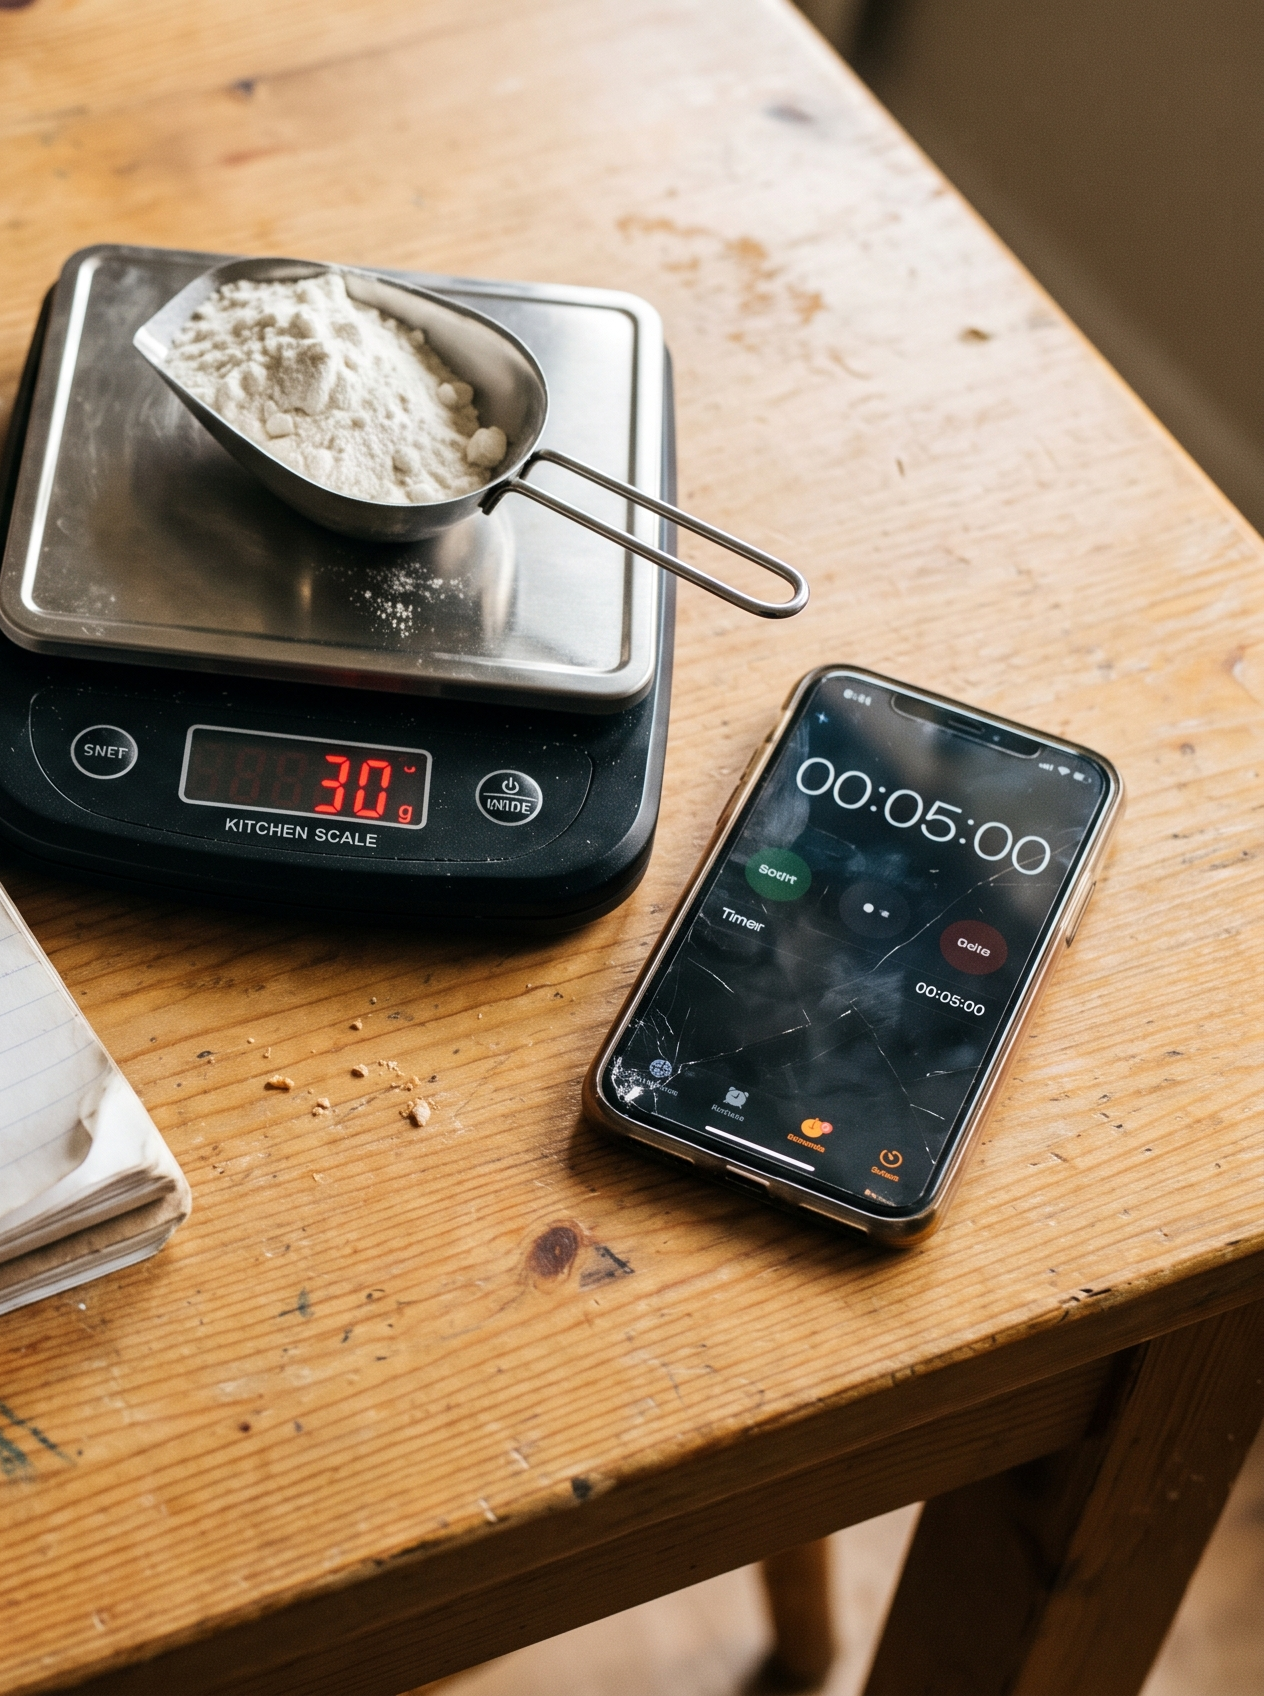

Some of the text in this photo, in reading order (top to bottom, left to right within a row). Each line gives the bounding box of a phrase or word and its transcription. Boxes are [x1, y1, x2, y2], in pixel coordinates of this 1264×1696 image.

[314, 755, 392, 818] 30
[225, 818, 378, 848] KITCHEN SCALE
[796, 756, 1050, 875] 00:05:00
[916, 982, 985, 1016] 00:05:00
